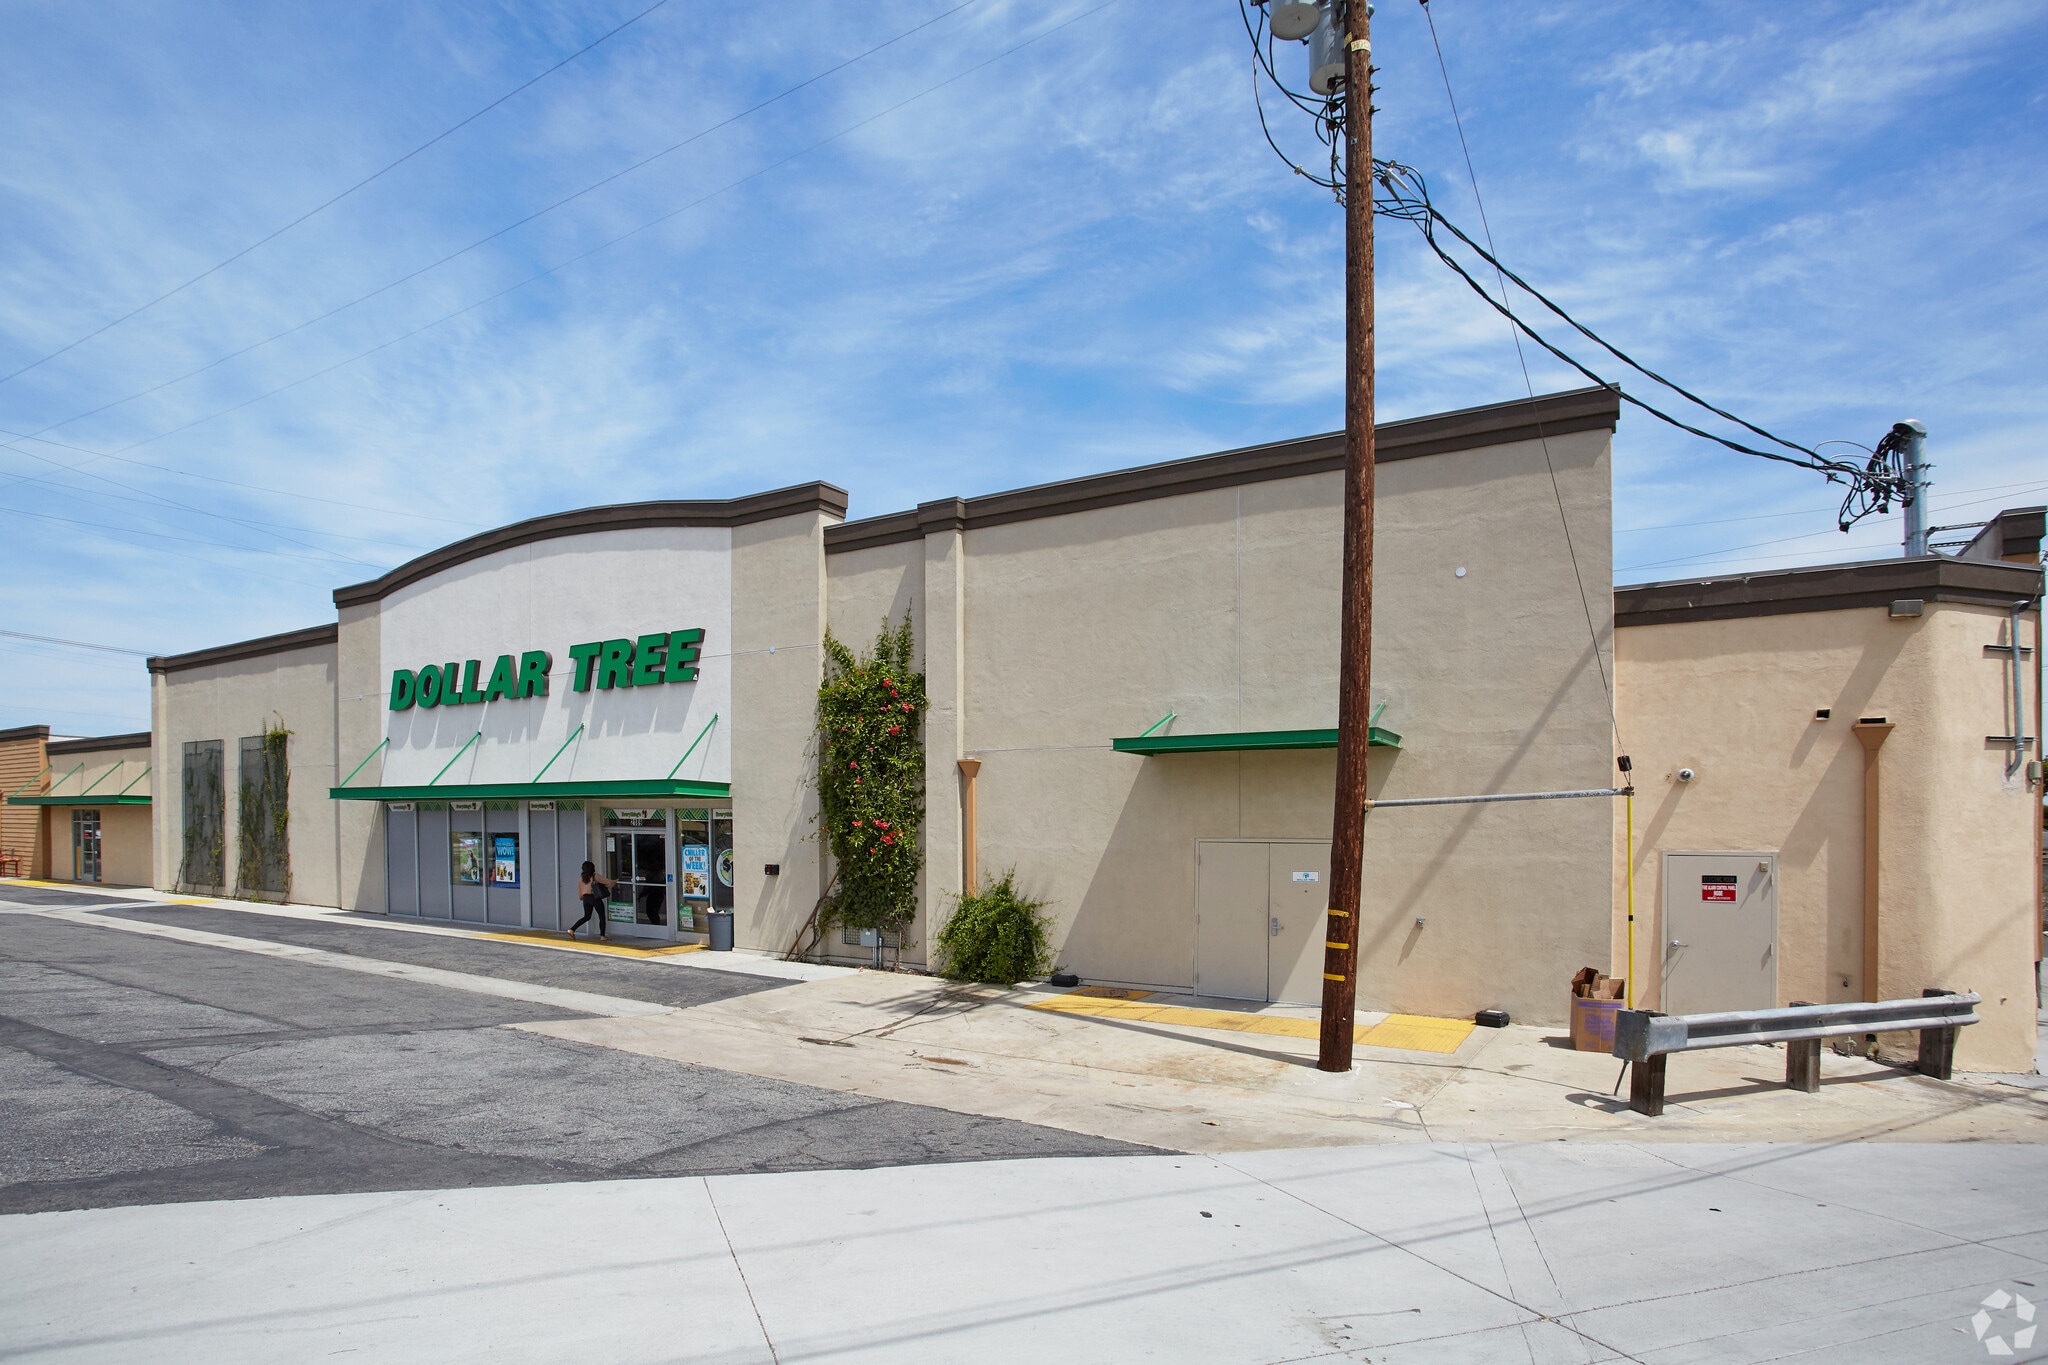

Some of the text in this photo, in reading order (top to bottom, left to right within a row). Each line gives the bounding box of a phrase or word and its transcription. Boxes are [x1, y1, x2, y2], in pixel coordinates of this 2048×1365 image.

[389, 628, 706, 711] DOLLAR TREE
[684, 849, 706, 857] CHILLER
[685, 861, 706, 870] WEEK!
